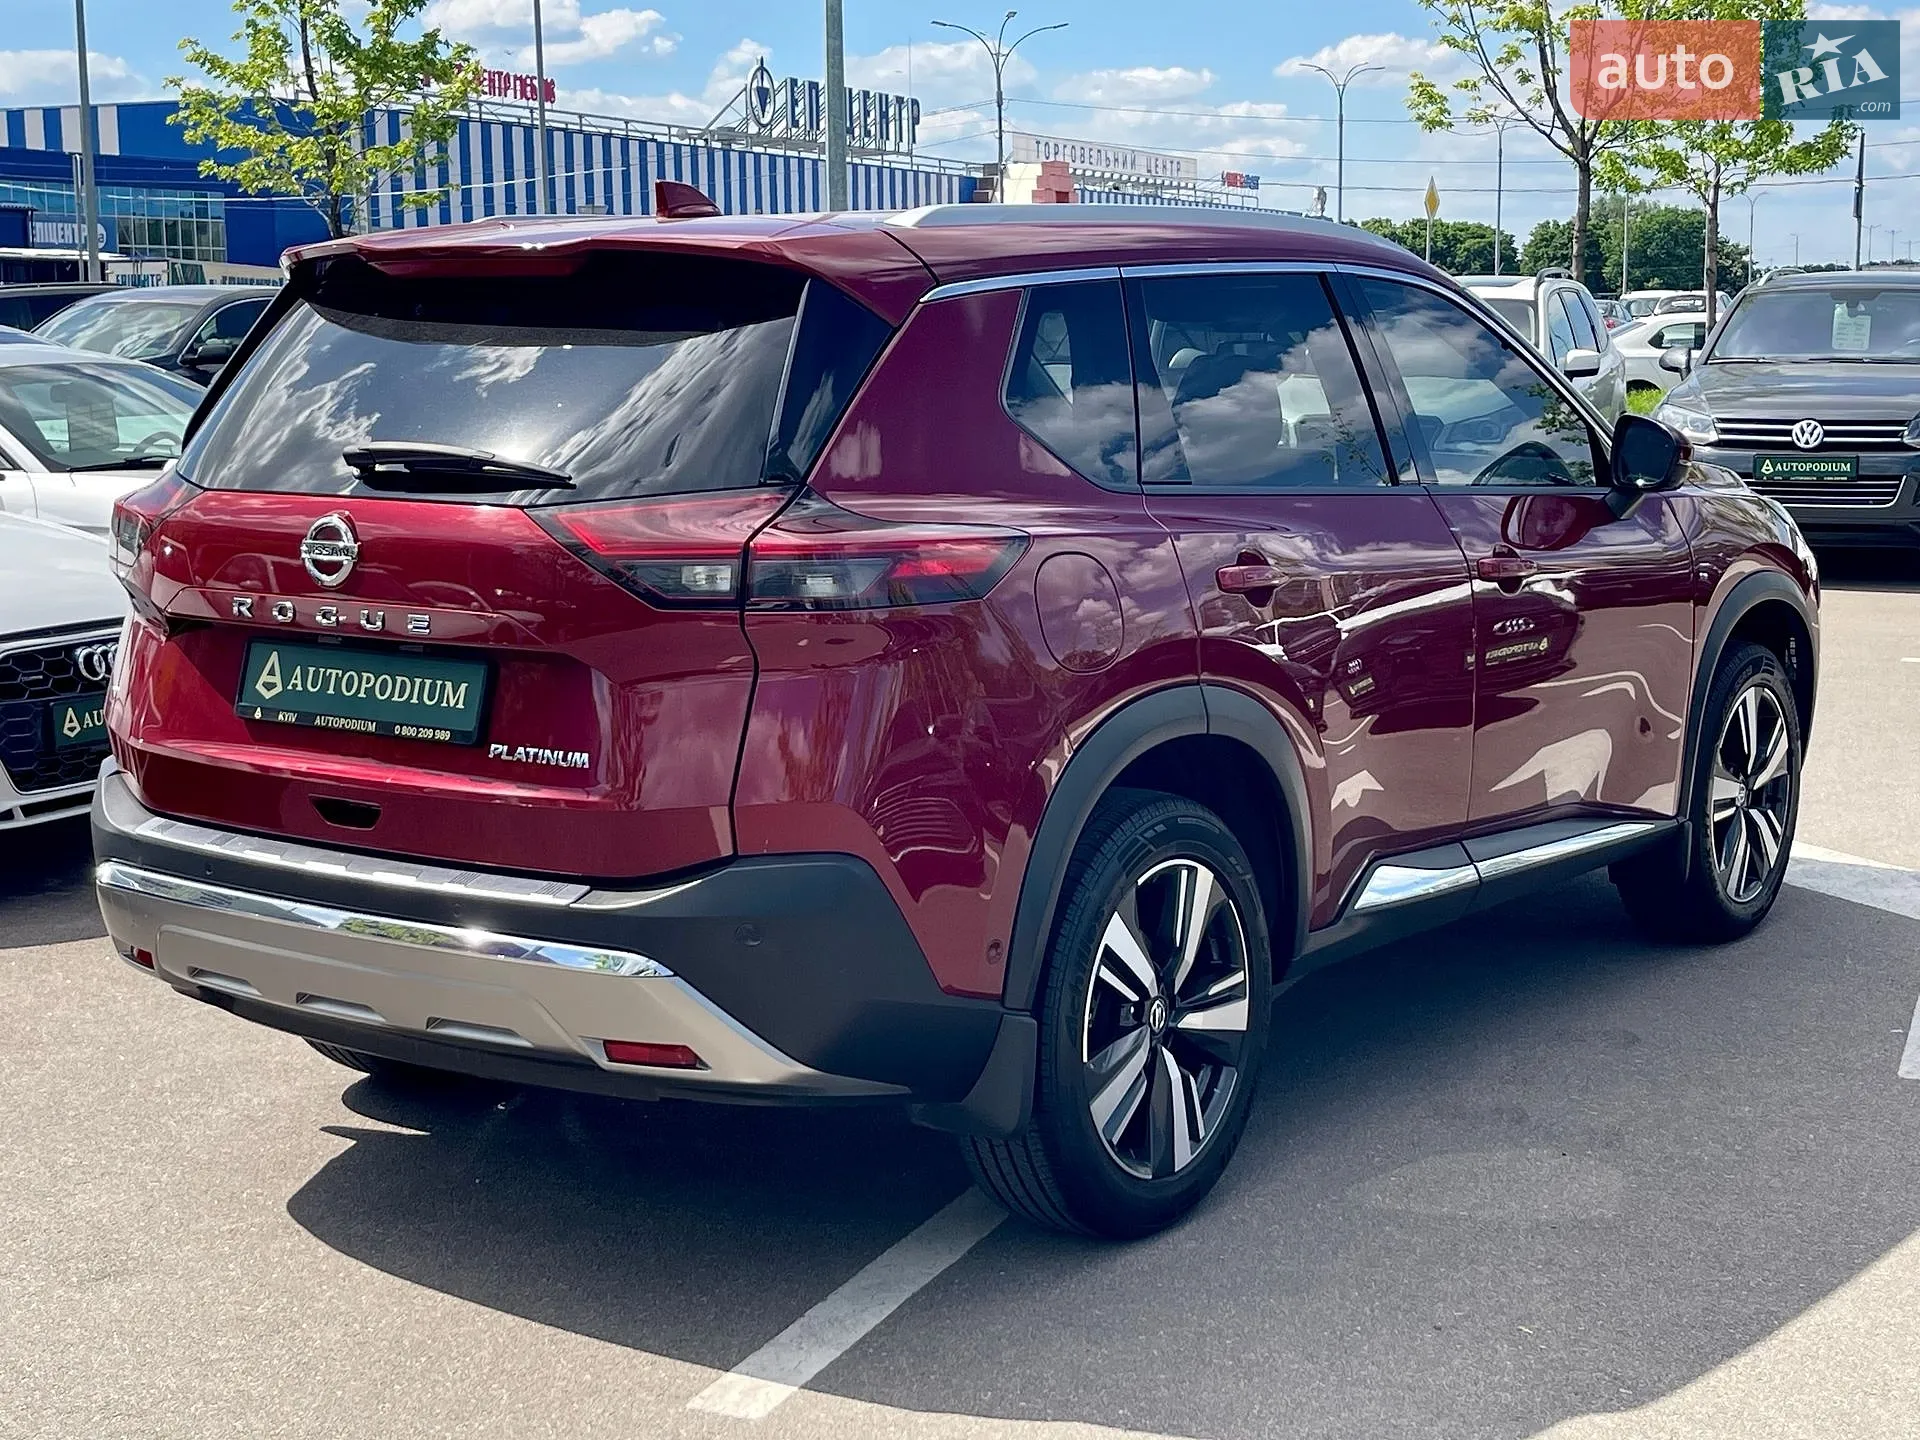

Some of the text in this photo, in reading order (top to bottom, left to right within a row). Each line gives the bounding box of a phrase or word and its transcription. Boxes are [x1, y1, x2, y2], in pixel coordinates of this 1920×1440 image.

[1034, 140, 1181, 177] ТОРГОВЕЛЬНИЙ ЦЕНТР
[1774, 462, 1851, 472] AUTOPODIUM
[232, 597, 430, 635] ROGUE
[286, 665, 469, 709] AUTOPODIUM
[277, 711, 451, 741] KYIV AUTOPODIUM 0 800 209 989
[488, 743, 590, 769] PLATINUM
